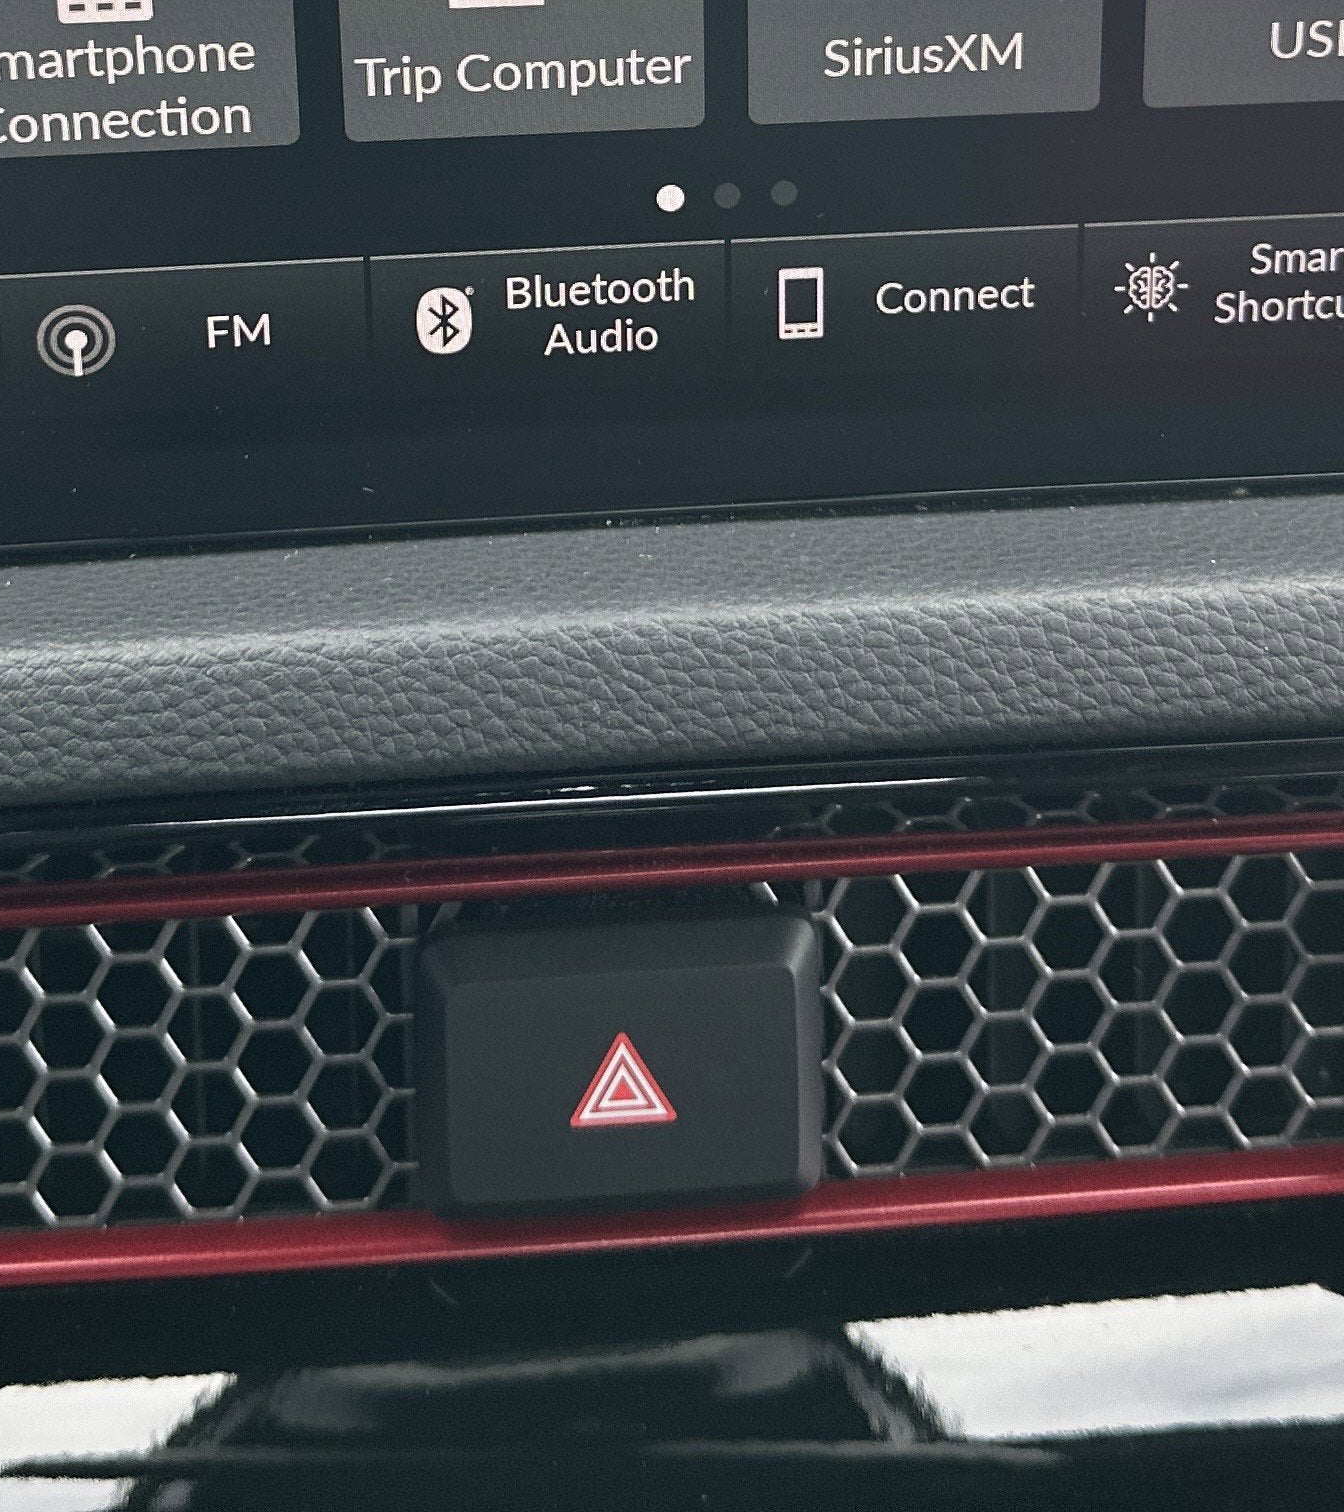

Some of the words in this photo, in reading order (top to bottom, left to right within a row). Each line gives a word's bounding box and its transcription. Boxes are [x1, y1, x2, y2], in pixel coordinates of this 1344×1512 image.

[353, 55, 442, 103] Trip
[456, 48, 692, 96] Computer
[824, 32, 1023, 78] SiriusXM
[506, 267, 695, 310] Bluetooth
[876, 276, 1036, 314] Connect
[206, 313, 271, 349] FM
[543, 317, 659, 356] Audio
